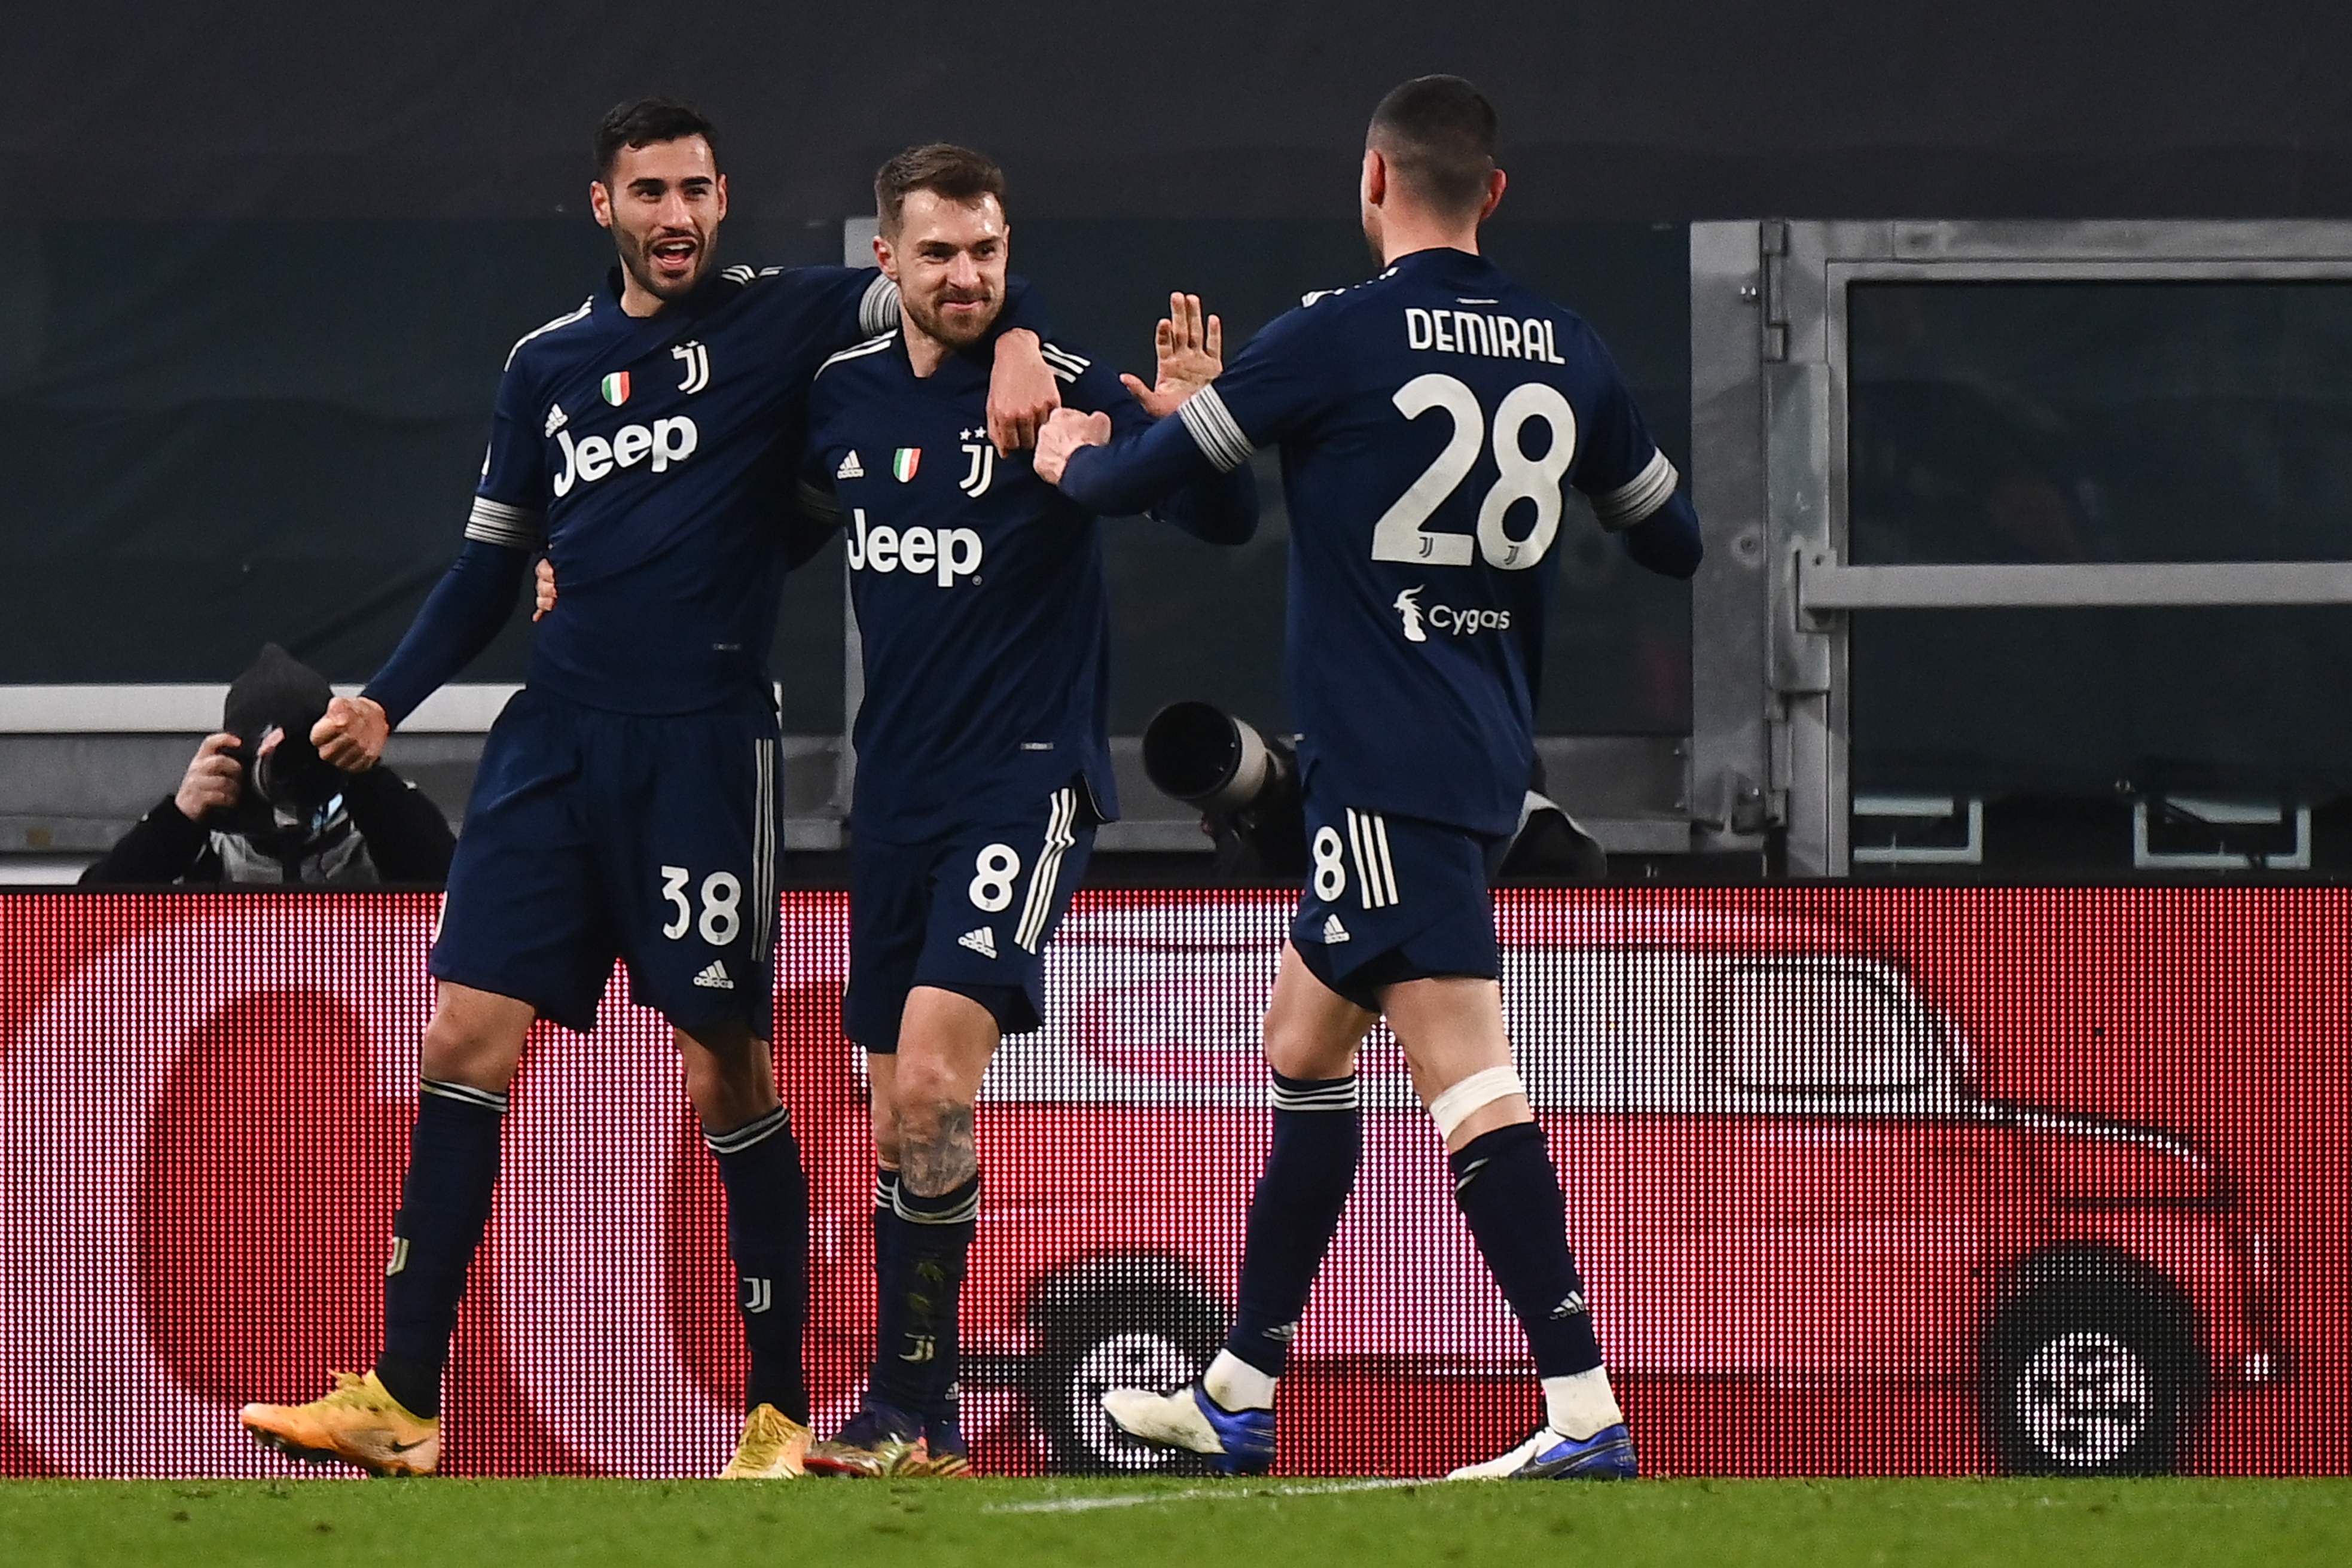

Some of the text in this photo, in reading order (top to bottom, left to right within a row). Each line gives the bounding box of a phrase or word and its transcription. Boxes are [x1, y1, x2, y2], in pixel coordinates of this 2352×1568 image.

[1405, 308, 1565, 364] DEMIRAL
[553, 416, 698, 498] Jeep
[1371, 373, 1576, 571] 28
[847, 508, 983, 587] Jeep
[1429, 605, 1510, 635] Cygas
[969, 843, 1020, 912] 8
[1313, 826, 1346, 902] 8
[661, 865, 741, 945] 38
